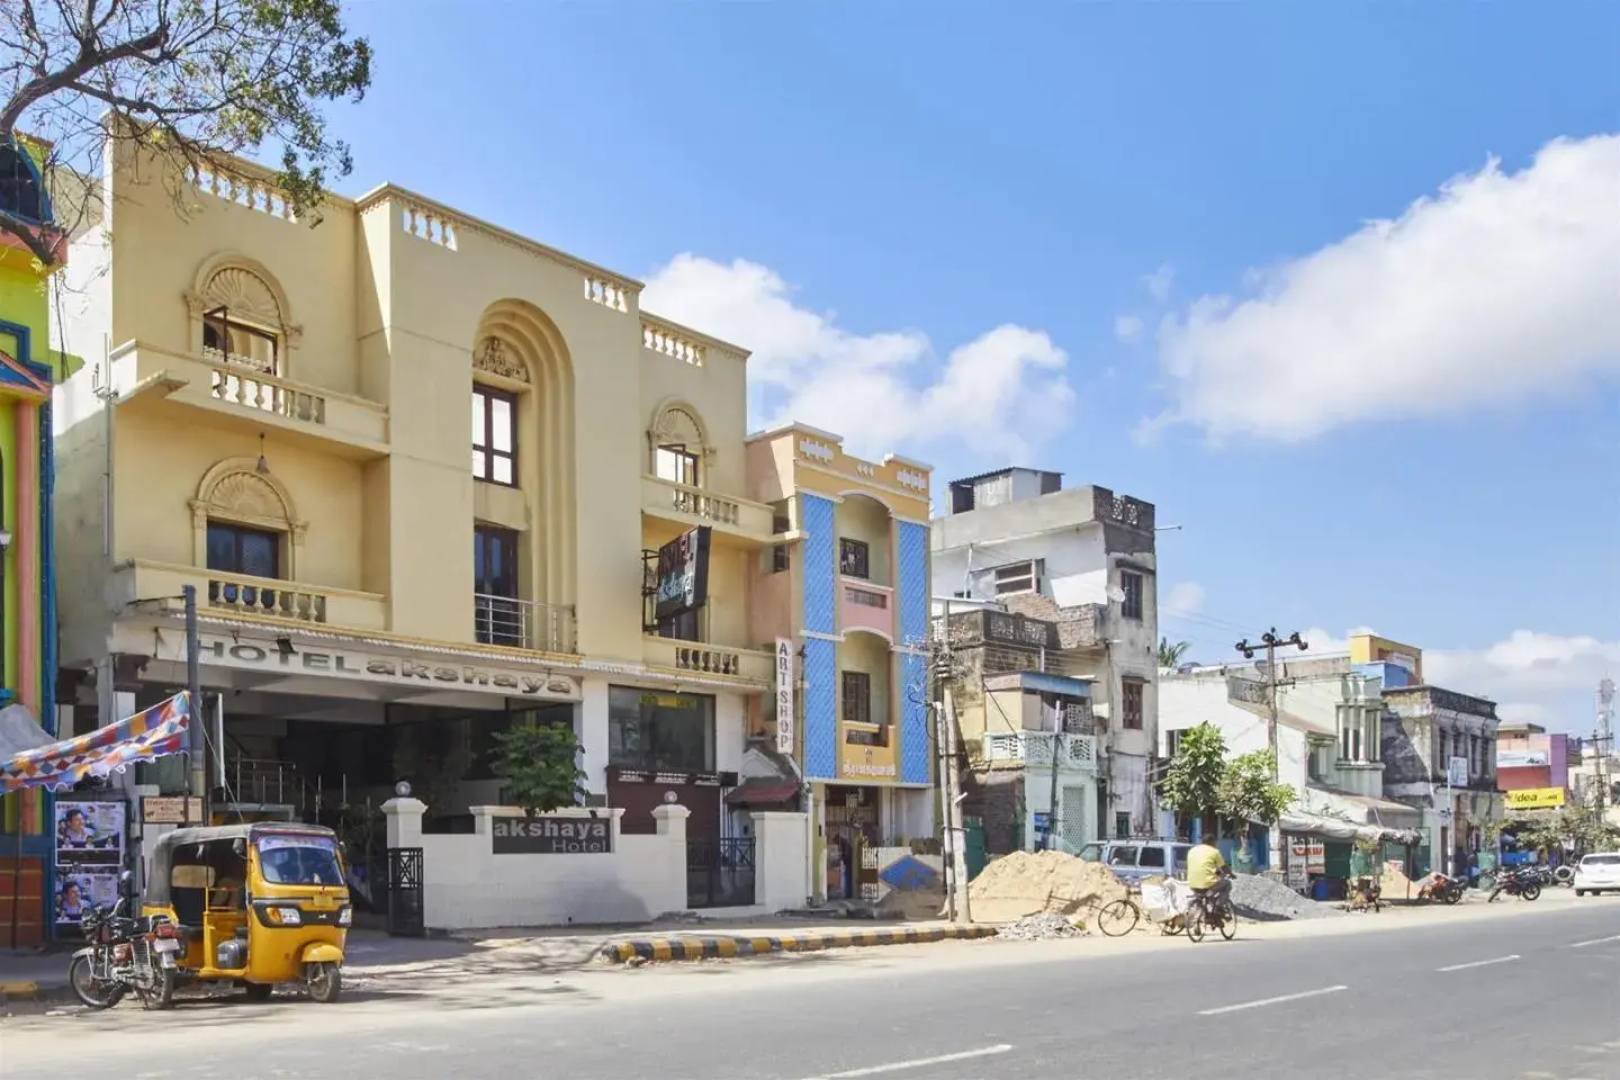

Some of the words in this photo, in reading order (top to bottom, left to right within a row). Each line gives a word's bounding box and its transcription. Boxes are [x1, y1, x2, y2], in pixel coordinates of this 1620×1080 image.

[198, 639, 361, 675] HOTEL
[366, 659, 571, 694] akshaya
[778, 641, 789, 686] ART
[779, 690, 790, 748] SHOP
[493, 819, 607, 840] akshaya
[551, 839, 607, 853] Hotel
